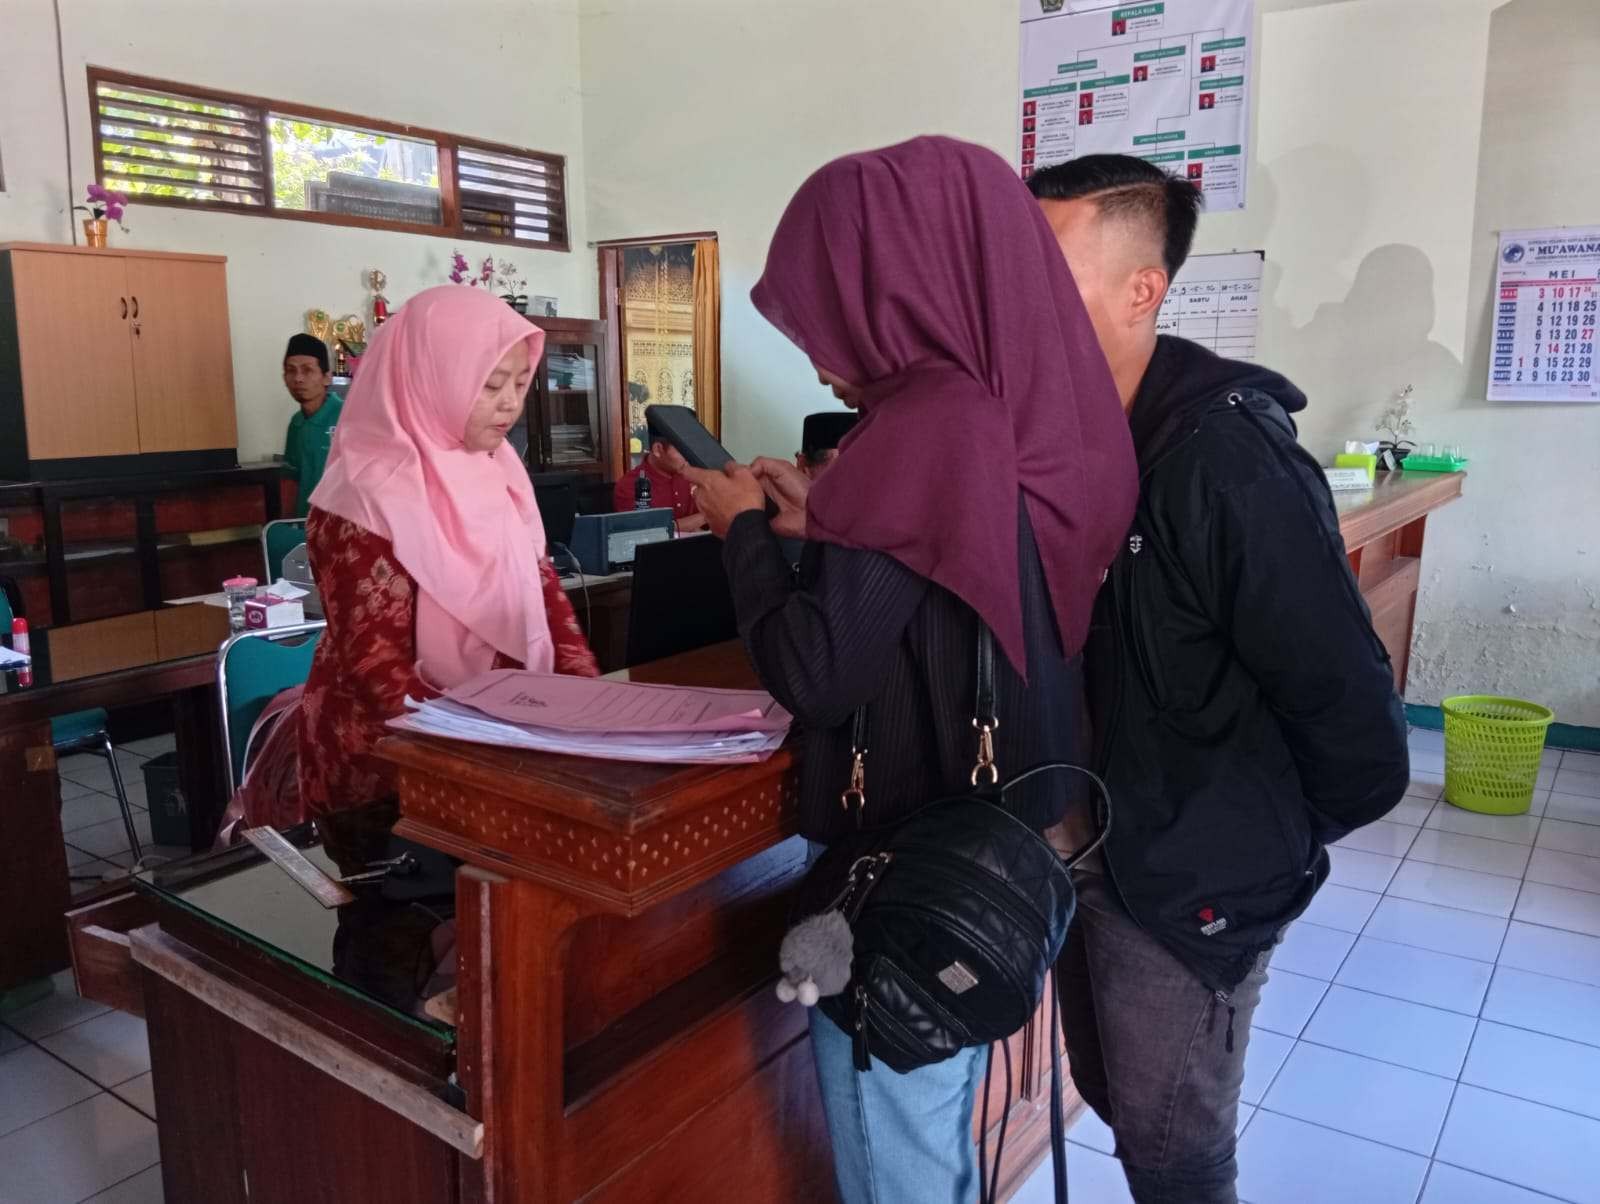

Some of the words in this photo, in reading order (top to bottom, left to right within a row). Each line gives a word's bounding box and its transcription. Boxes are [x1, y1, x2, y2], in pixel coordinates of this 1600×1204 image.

[1548, 269, 1576, 279] MEI
[1539, 288, 1545, 299] 3
[1552, 287, 1564, 298] 10
[1569, 286, 1581, 298] 17
[1537, 302, 1544, 312] 4
[1552, 302, 1563, 312] 11
[1568, 301, 1580, 312] 18
[1583, 300, 1597, 312] 25
[1536, 315, 1543, 326] 5
[1550, 315, 1562, 326] 12
[1567, 315, 1578, 326] 19
[1582, 314, 1595, 326] 26
[1535, 329, 1541, 340] 6
[1549, 329, 1560, 340] 13
[1565, 328, 1577, 340] 20
[1582, 328, 1594, 340] 27
[1535, 343, 1541, 354] 7
[1547, 343, 1559, 353] 14
[1564, 343, 1576, 354] 21
[1580, 342, 1592, 353] 28
[1518, 356, 1523, 368] 1
[1533, 357, 1539, 368] 8
[1547, 357, 1558, 368] 15
[1562, 357, 1574, 368] 22
[1579, 357, 1591, 368] 29
[1516, 371, 1522, 381] 2
[1532, 371, 1538, 381] 9
[1546, 371, 1557, 381] 16
[1561, 370, 1573, 381] 23
[1577, 371, 1590, 381] 30
